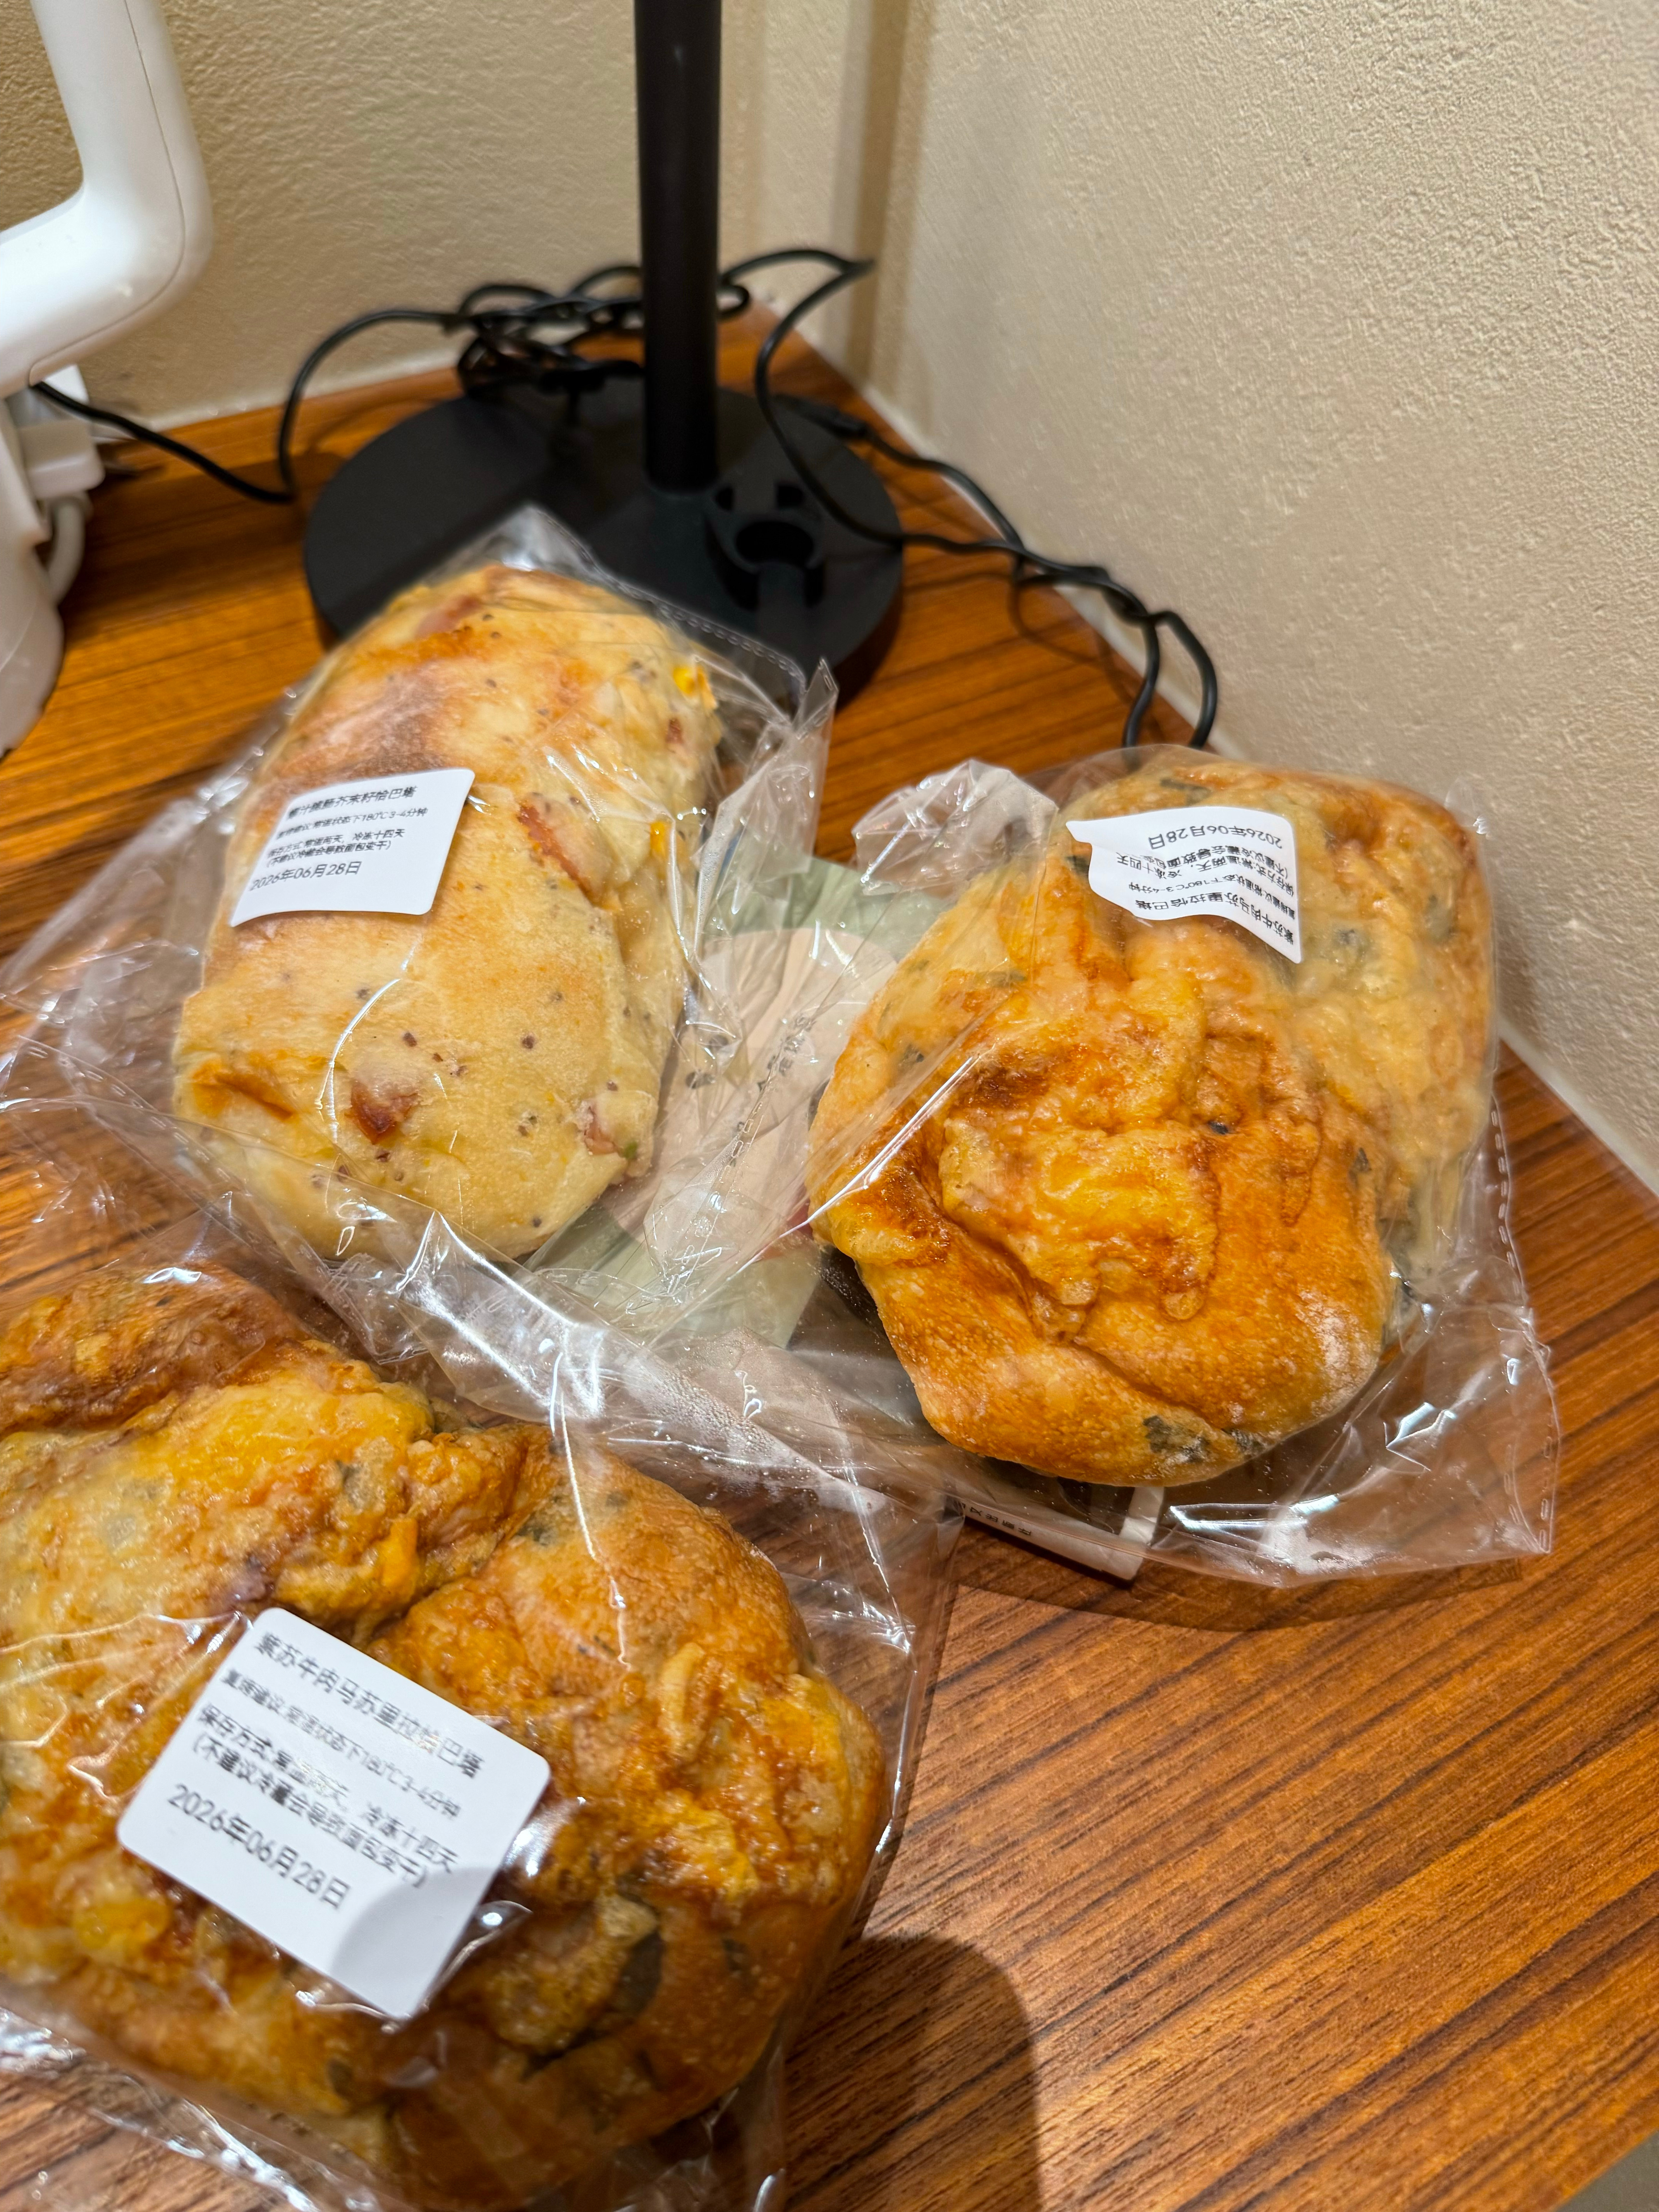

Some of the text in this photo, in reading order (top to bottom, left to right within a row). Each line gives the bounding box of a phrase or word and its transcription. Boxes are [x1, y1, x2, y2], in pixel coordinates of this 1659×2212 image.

[1148, 825, 1283, 850] 2026年06月28日
[249, 861, 362, 891] 2026年06月28日
[1135, 892, 1293, 944] 紫苏牛肉马苏里拉恰巴塔
[961, 1503, 1032, 1536] 文出版社
[254, 1633, 484, 1779] 紫苏牛肉马苏里拉恰巴塔
[168, 1784, 351, 1910] 2026年06月28日
